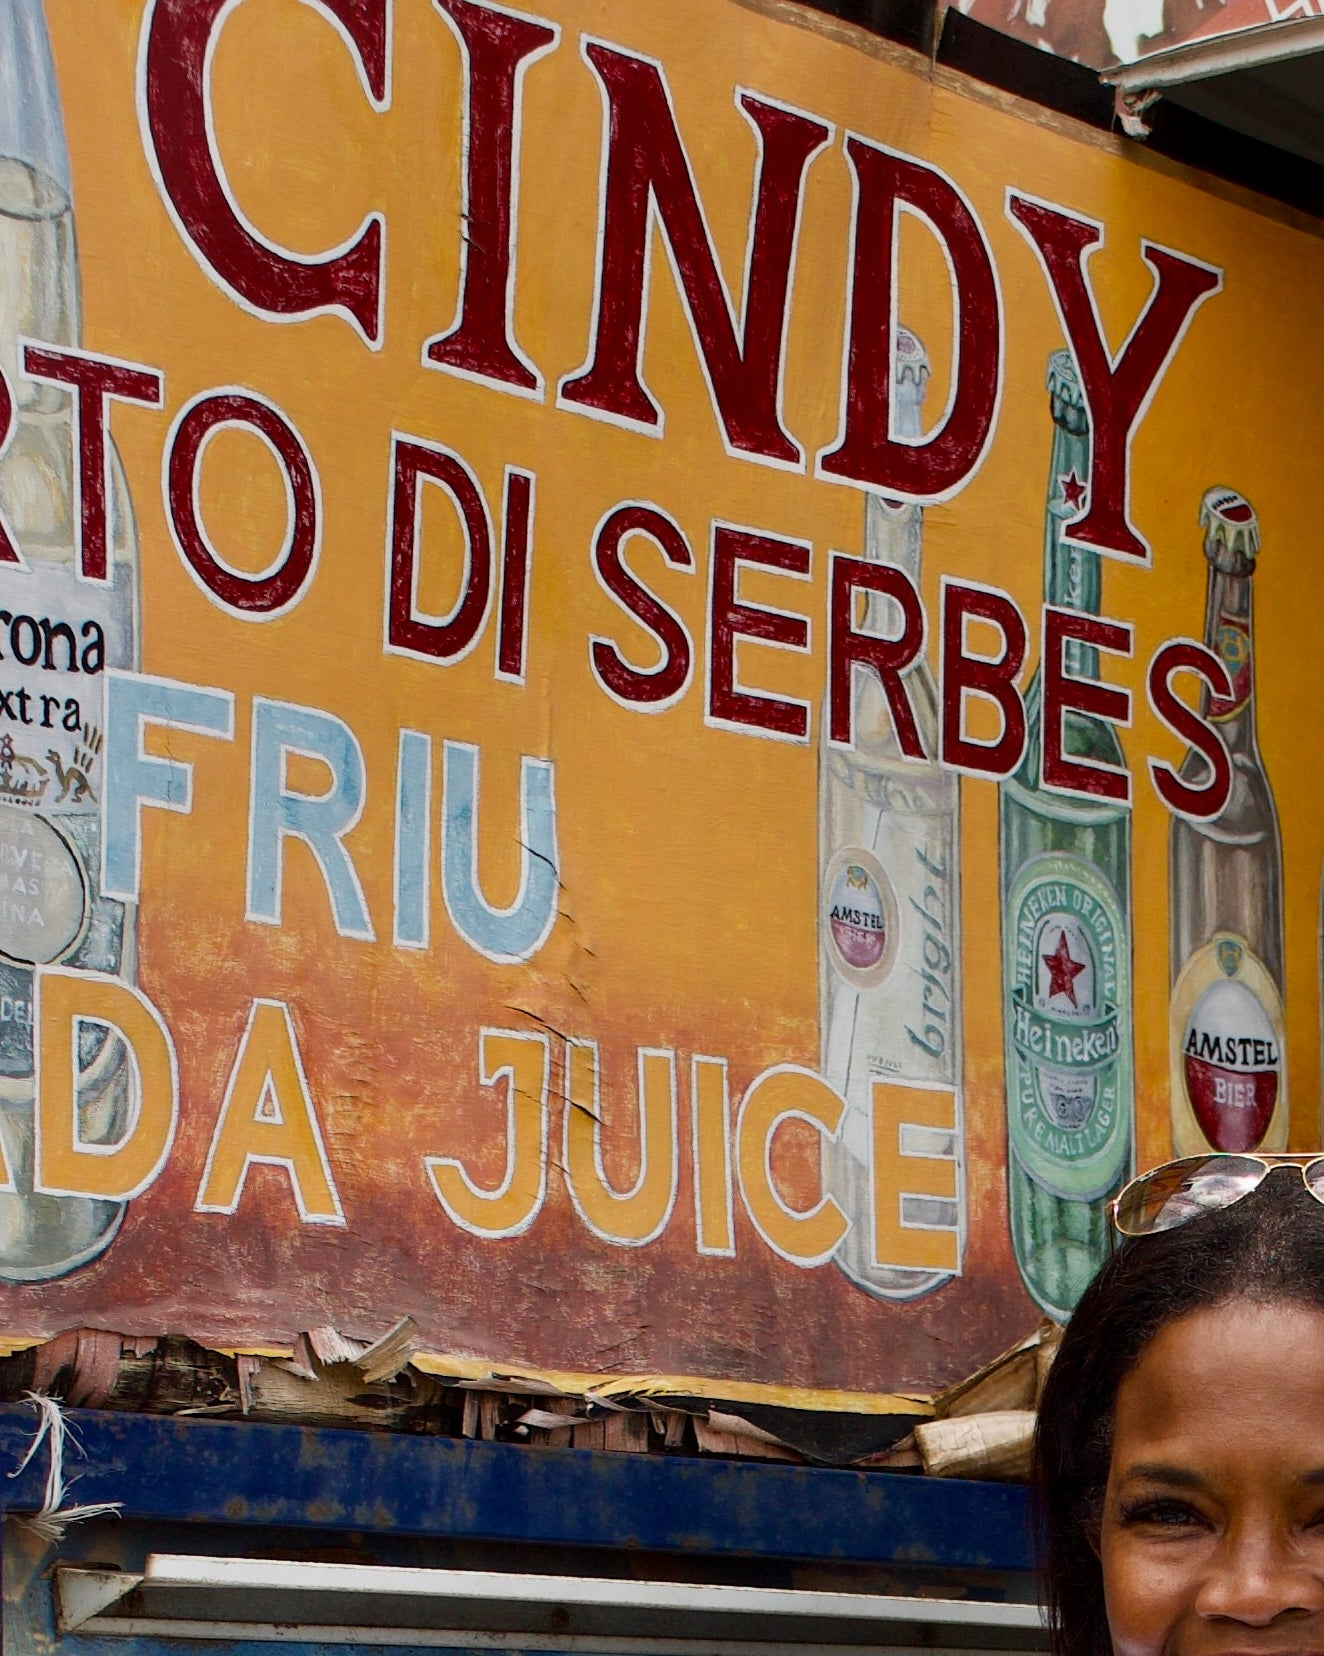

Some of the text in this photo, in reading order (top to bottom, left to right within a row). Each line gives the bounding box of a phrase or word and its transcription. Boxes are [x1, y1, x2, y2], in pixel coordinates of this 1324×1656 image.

[135, 0, 1224, 569] CINDY
[0, 335, 324, 624] TO
[383, 430, 535, 686] DI
[588, 500, 1236, 823] SERBES
[102, 668, 560, 964] FRIU
[829, 904, 884, 930] AMSTEL
[1016, 885, 1069, 989] HEINEKEN
[1072, 887, 1118, 998] ORIGINAL
[1015, 1005, 1117, 1063] Heineken
[1185, 1028, 1279, 1066] AMSTEL
[0, 963, 962, 1277] DA JUICE
[1046, 1130, 1086, 1157] MALT
[1084, 1086, 1116, 1148] LAGER
[1213, 1076, 1258, 1108] BIER
